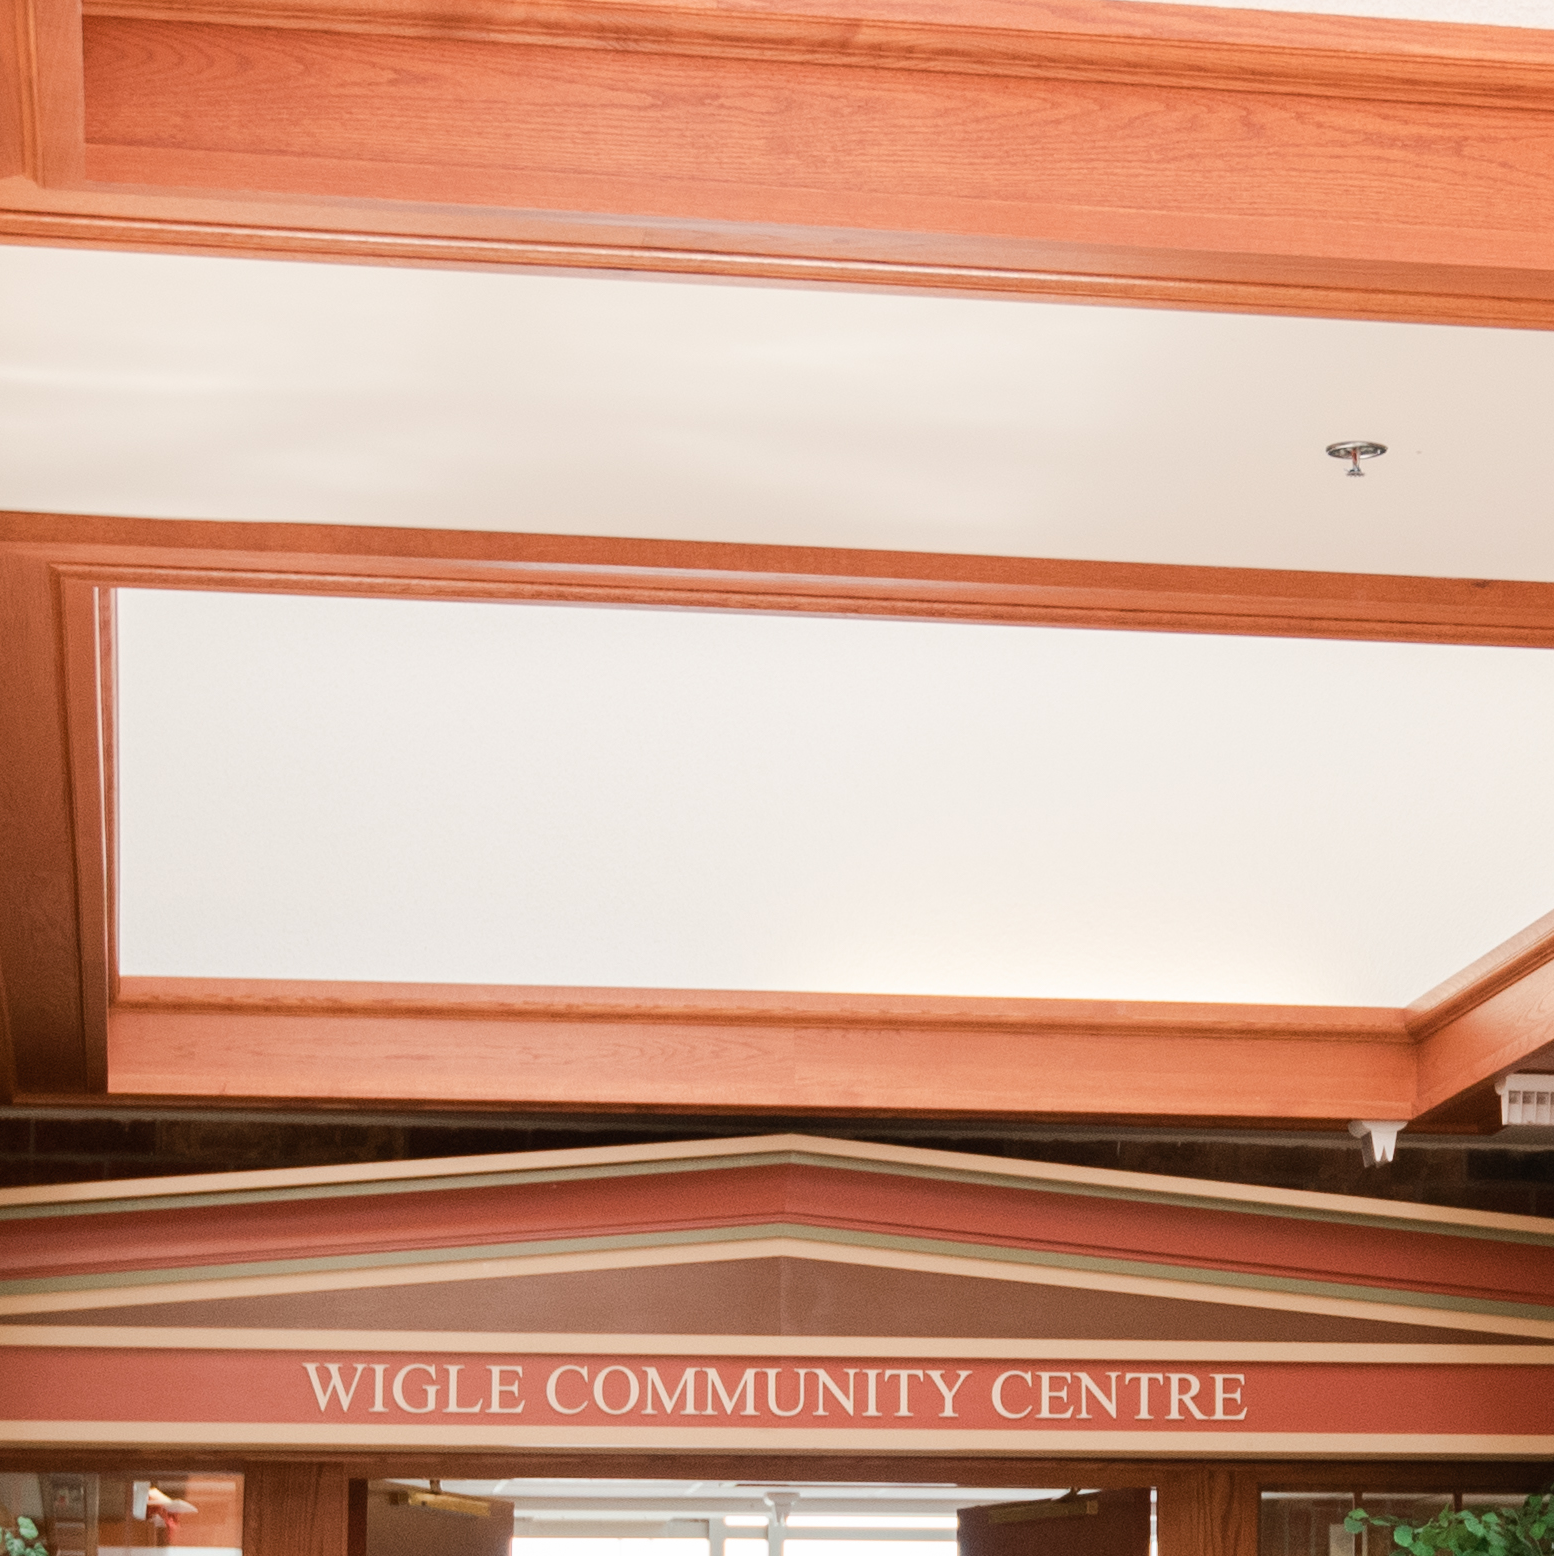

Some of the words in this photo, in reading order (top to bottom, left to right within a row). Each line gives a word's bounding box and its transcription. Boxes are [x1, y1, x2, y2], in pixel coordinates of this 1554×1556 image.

[301, 1361, 525, 1414] WIGLE
[545, 1364, 974, 1418] COMMUNITY
[990, 1369, 1248, 1422] CENTRE
